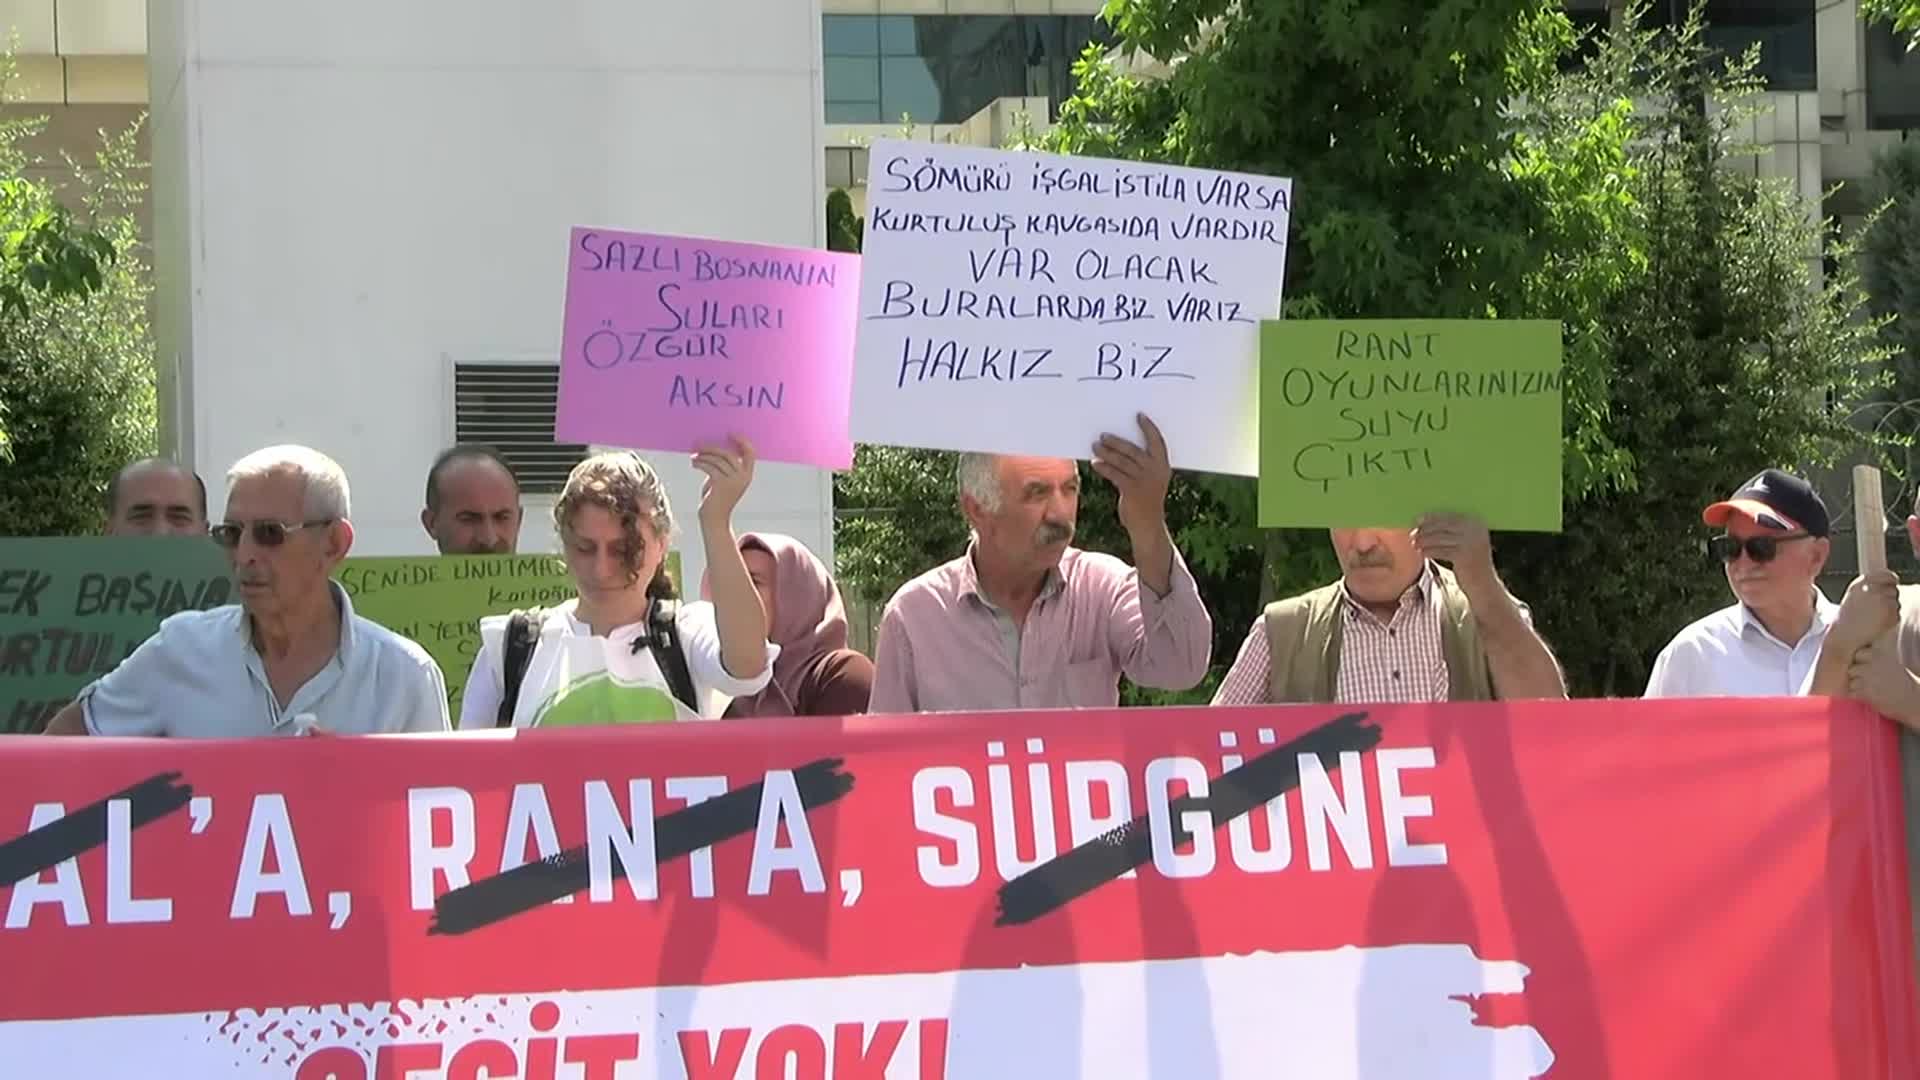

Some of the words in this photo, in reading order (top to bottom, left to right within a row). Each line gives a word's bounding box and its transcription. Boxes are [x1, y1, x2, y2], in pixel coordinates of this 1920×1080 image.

[882, 156, 1011, 194] SÖMÜRÜ
[1032, 161, 1108, 196] İŞGAL
[1196, 175, 1291, 213] VARSA
[872, 206, 1017, 246] KURTULUŞ
[1171, 213, 1283, 245] VARDIR
[581, 233, 681, 273] SAZLI
[692, 249, 836, 288] BOSNANIN
[969, 248, 1056, 284] VAR
[1076, 248, 1218, 285] OLACAK
[648, 283, 784, 332] SULARI
[867, 280, 1104, 323] BURALARDA
[1099, 293, 1155, 325] BİZ
[1167, 292, 1256, 323] VARIZ
[898, 337, 1063, 388] HALKIZ
[1078, 342, 1196, 382] BİZ
[1336, 329, 1441, 361] RANT
[669, 374, 784, 410] AKSIN
[1327, 404, 1449, 442] SUYU
[1293, 443, 1433, 493] ÇIKTI
[75, 570, 231, 617] BAŞINA
[408, 769, 863, 910] RANTA,
[911, 727, 1449, 888] SÜRGÜNE
